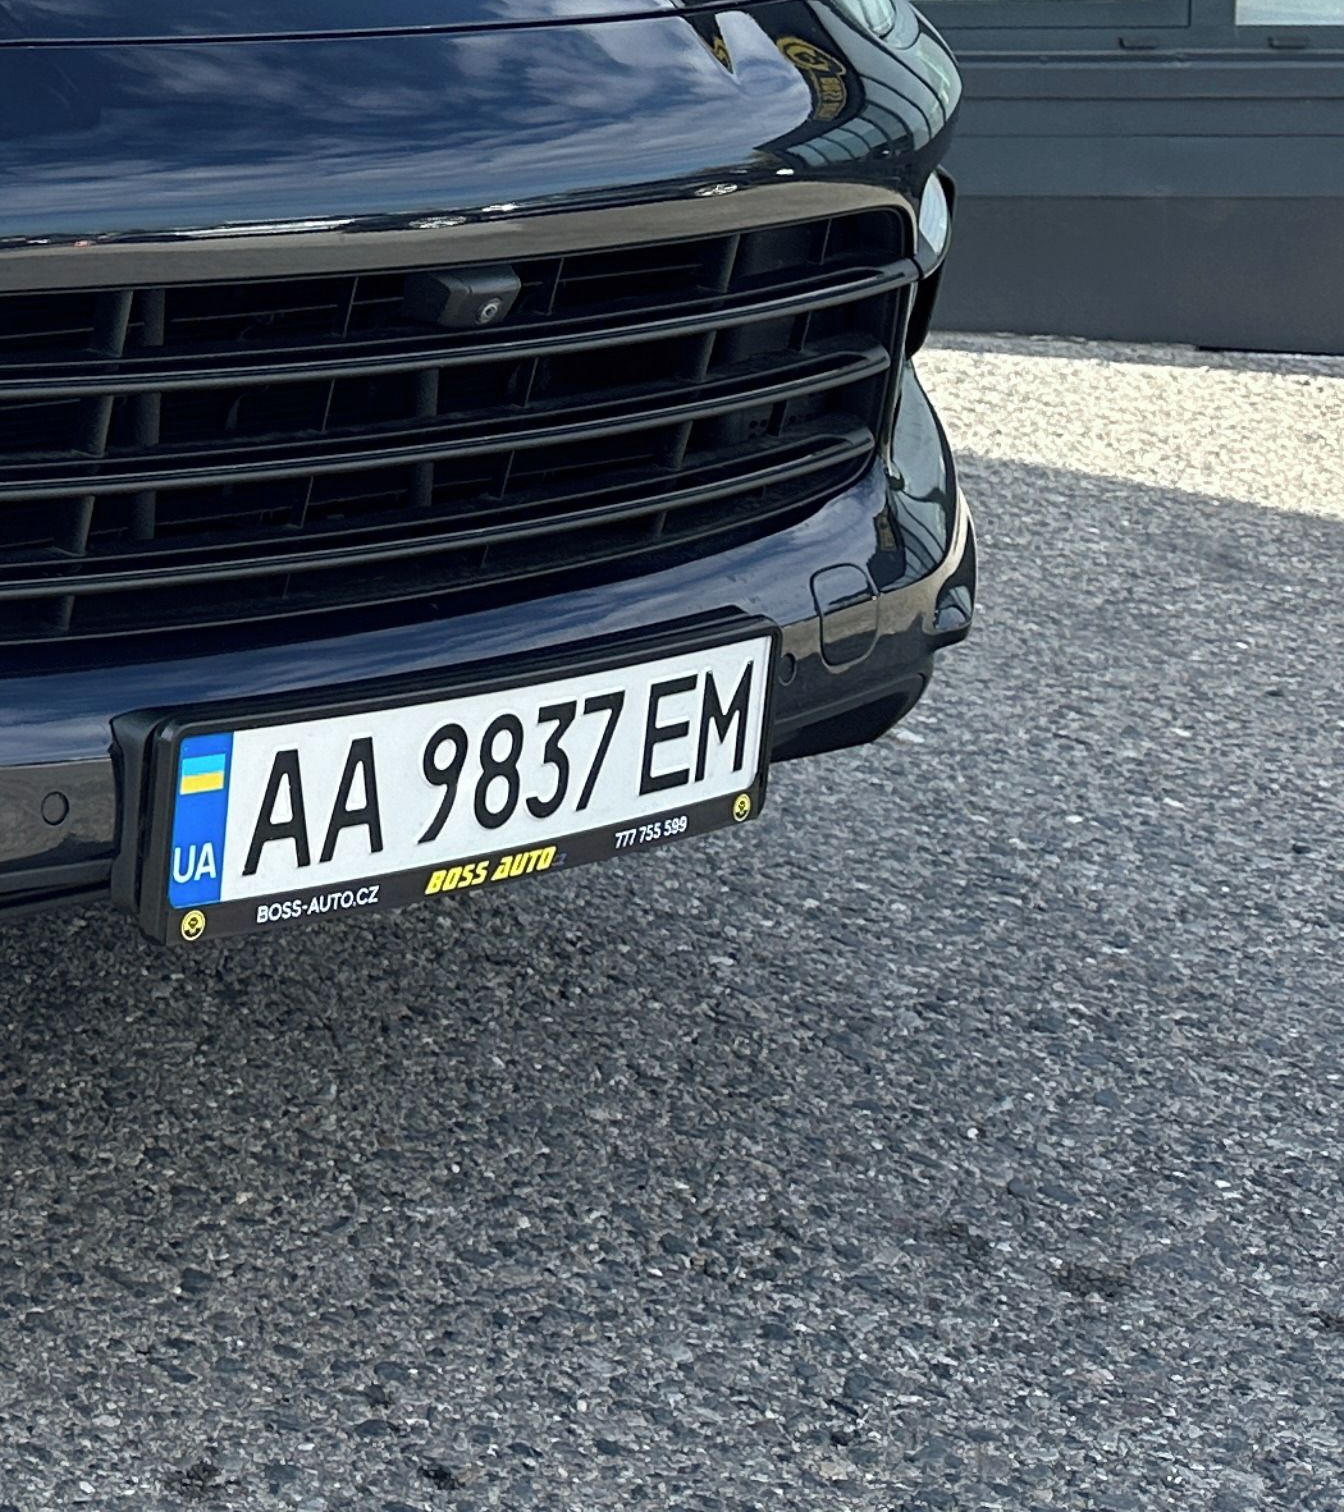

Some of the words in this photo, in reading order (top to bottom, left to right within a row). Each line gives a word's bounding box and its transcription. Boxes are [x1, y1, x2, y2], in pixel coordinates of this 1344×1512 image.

[242, 737, 384, 876] AA
[417, 690, 626, 845] 9837
[638, 660, 755, 797] EM
[173, 842, 217, 884] UA
[257, 885, 380, 924] BOSS-AUTO.CZ
[424, 860, 490, 895] BOSS
[490, 845, 557, 881] AUTO
[615, 828, 637, 849] 777
[638, 822, 661, 844] 755
[663, 815, 687, 836] 599
